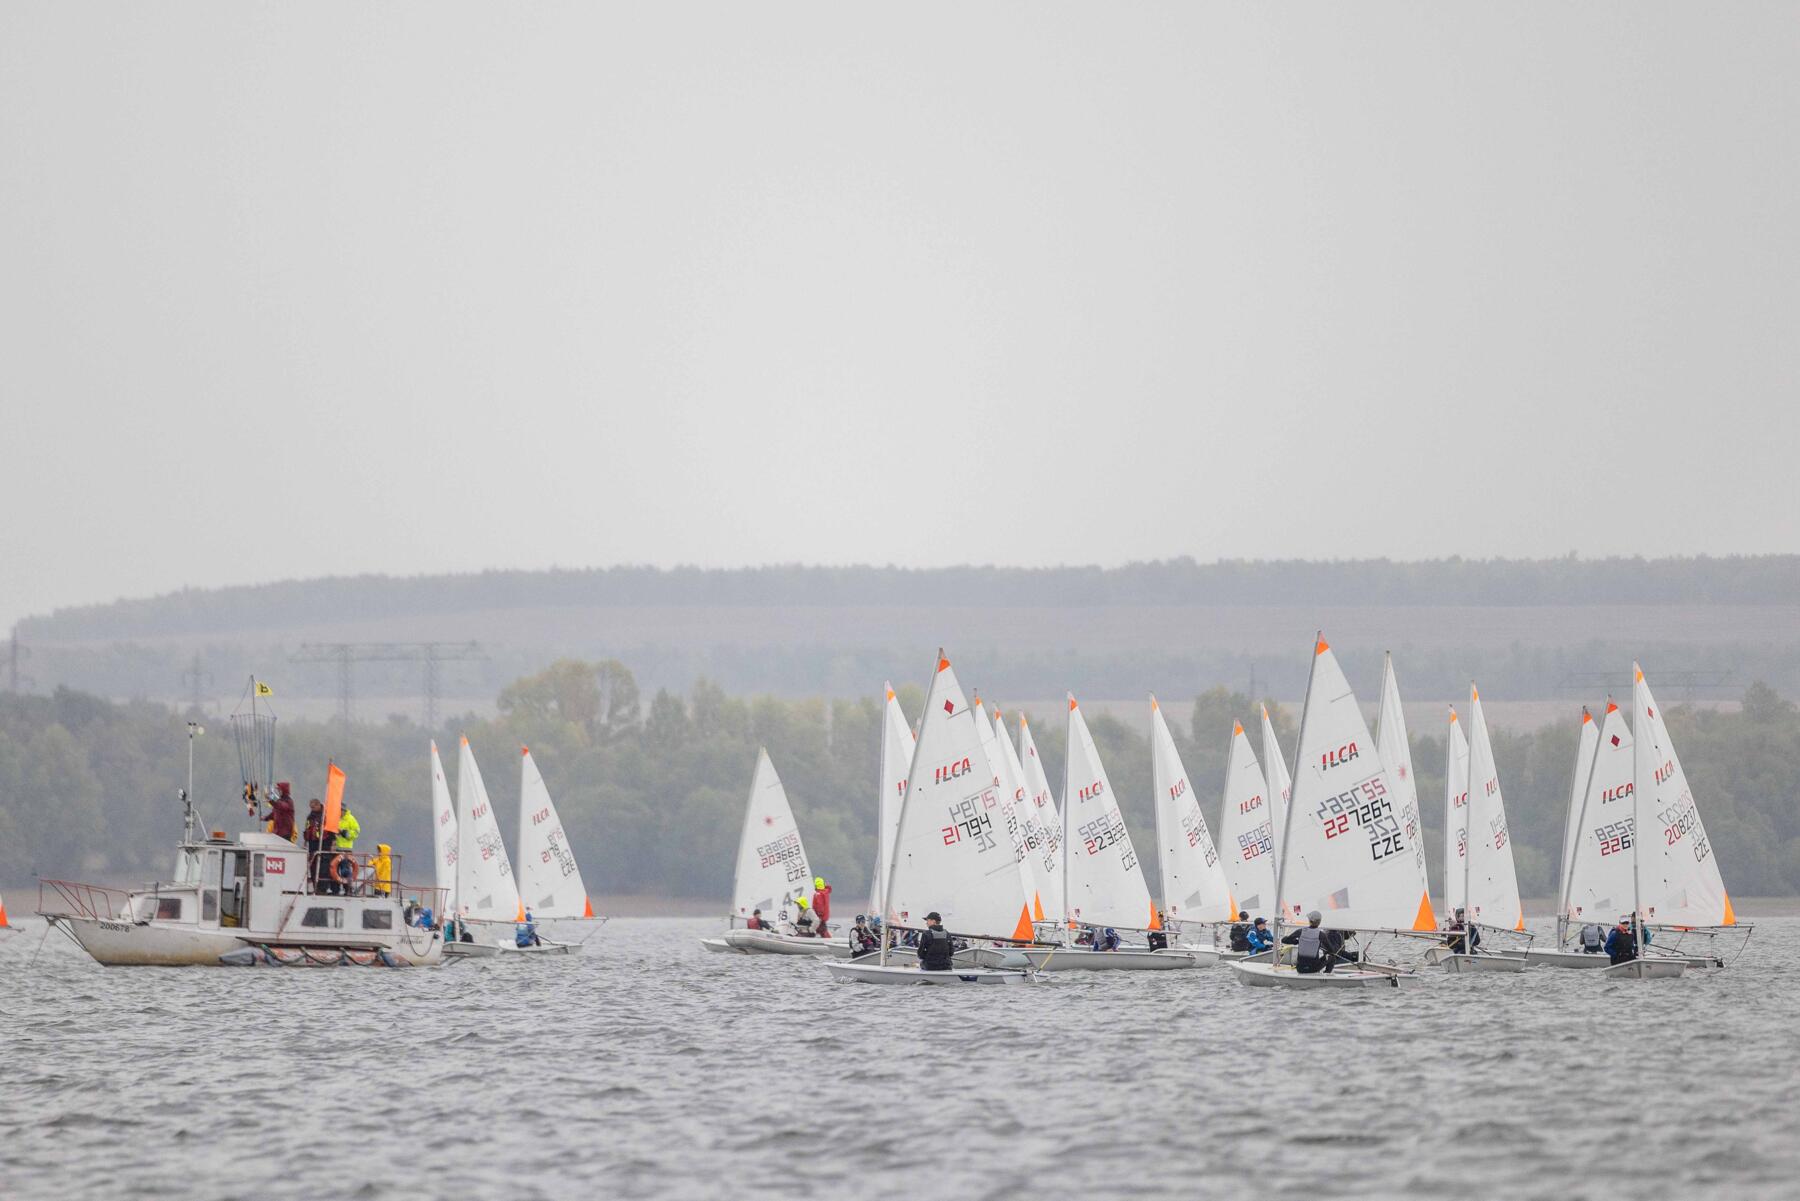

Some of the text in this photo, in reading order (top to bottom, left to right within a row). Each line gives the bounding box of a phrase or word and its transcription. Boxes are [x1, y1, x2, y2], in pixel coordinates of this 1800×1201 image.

[1322, 742, 1359, 771] ILCA
[935, 757, 972, 785] ILCA
[1655, 759, 1675, 786] ILCA
[1240, 795, 1263, 815] ILCA
[1323, 798, 1393, 840] 227264
[941, 811, 992, 846] 21794
[1664, 805, 1697, 846] 208237
[761, 844, 801, 869] 203663
[1371, 832, 1405, 861] CZE
[1693, 838, 1710, 863] CZE
[787, 866, 808, 883] CZE
